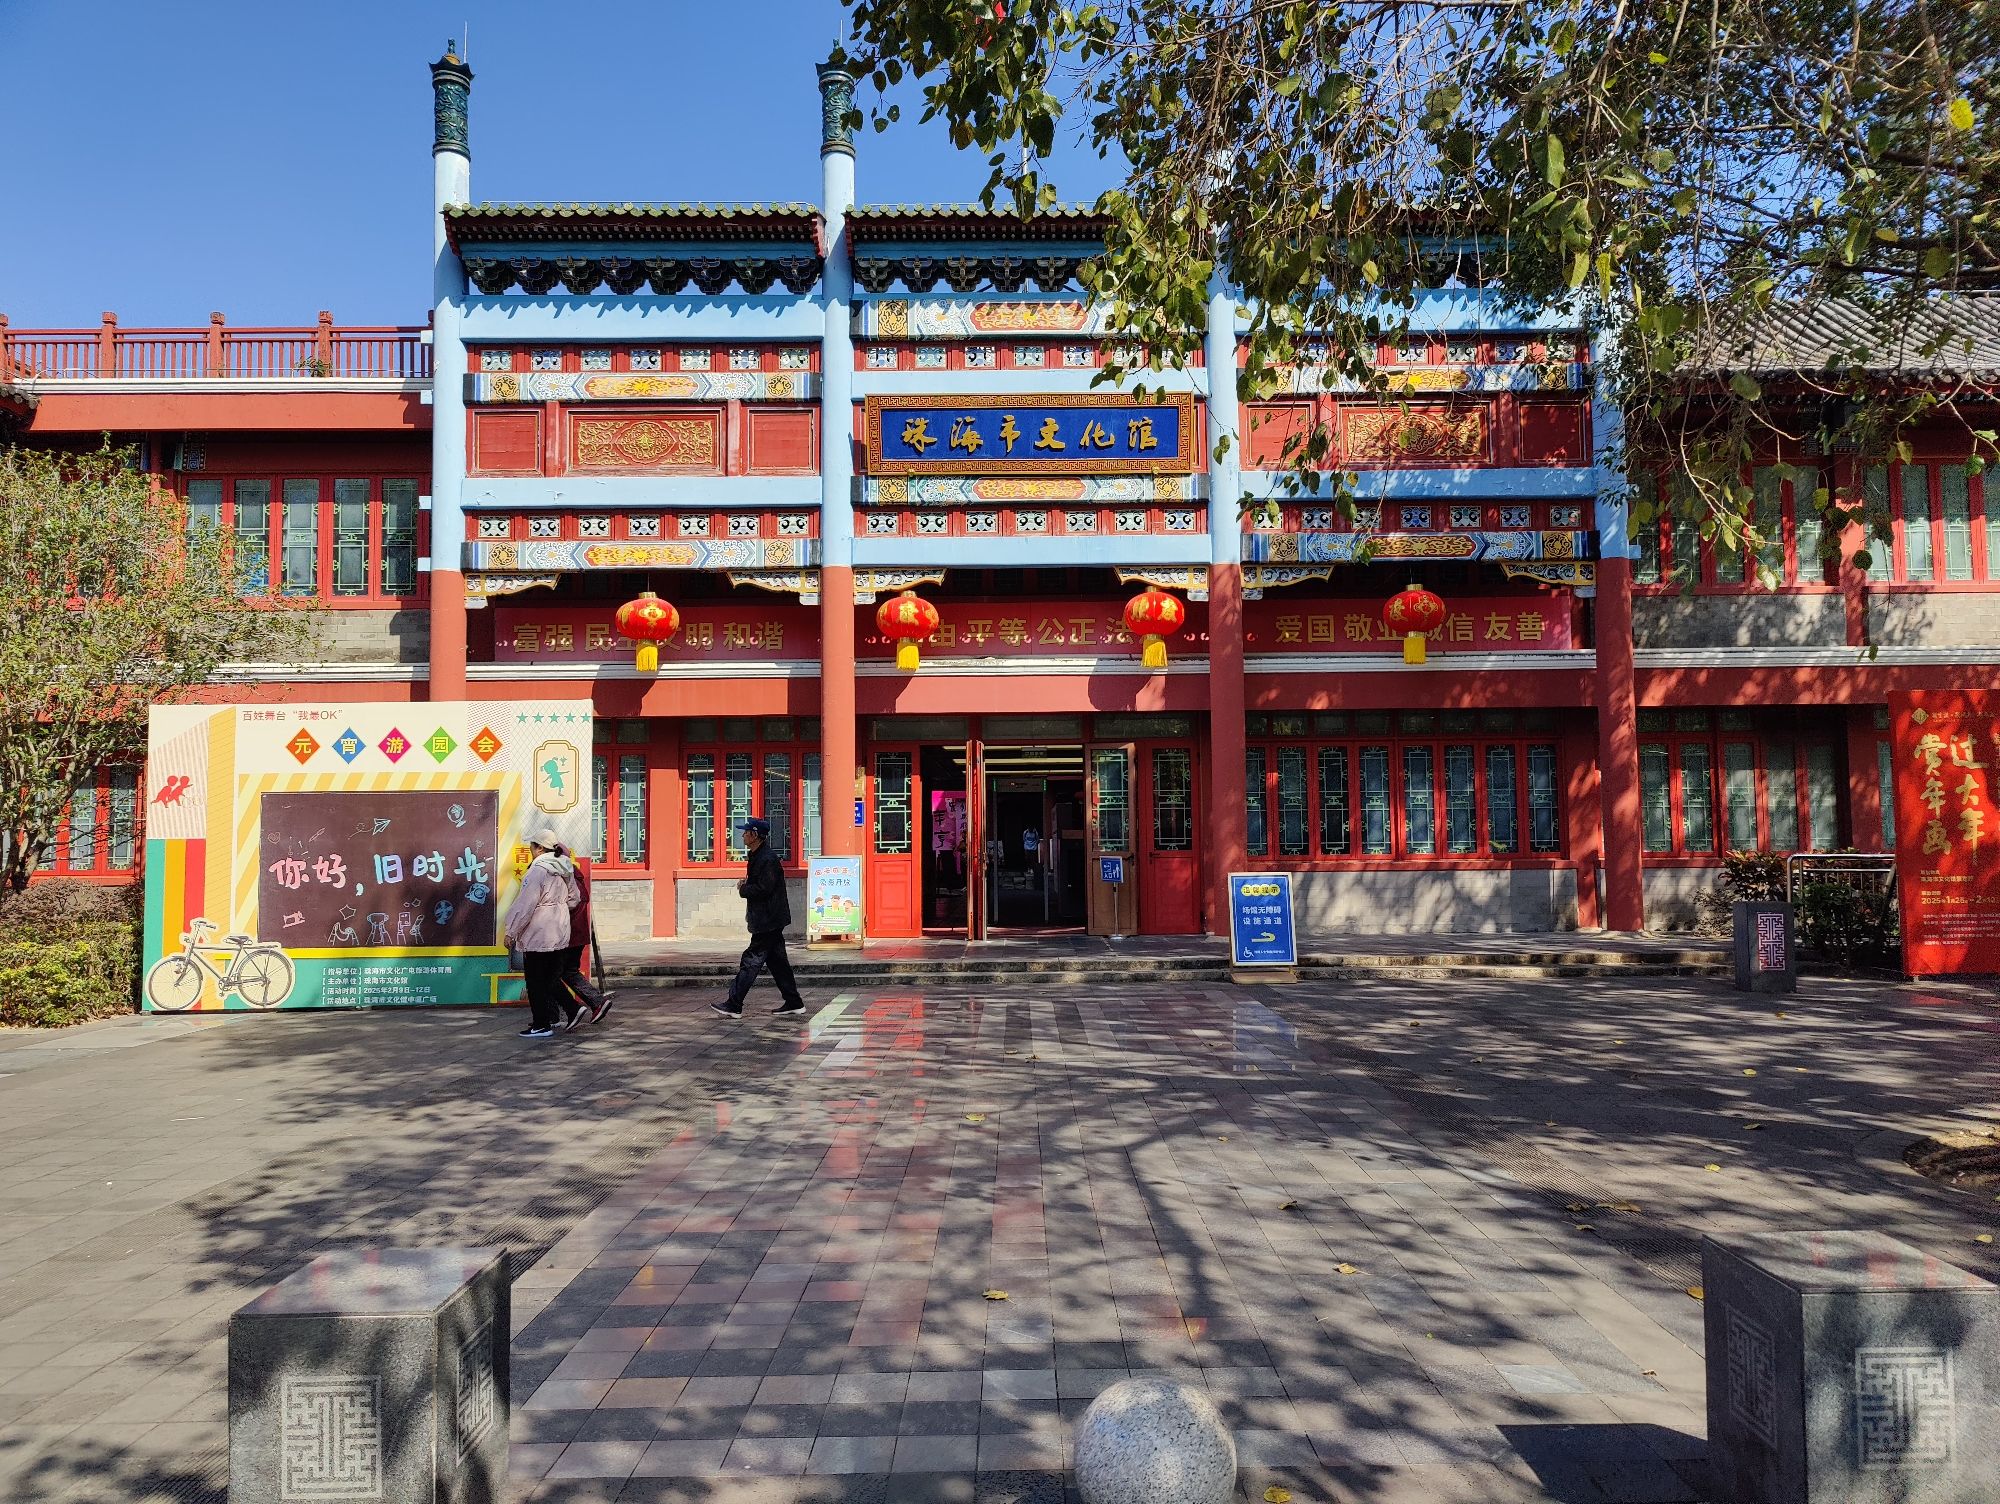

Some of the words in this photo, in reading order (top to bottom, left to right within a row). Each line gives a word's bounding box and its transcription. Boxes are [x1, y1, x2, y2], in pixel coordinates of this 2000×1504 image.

[901, 414, 1159, 455] 珠海市文化馆
[513, 623, 574, 653] 富强
[722, 621, 784, 651] 和谐
[967, 617, 1027, 648] 平等
[1036, 617, 1097, 647] 公正
[1275, 615, 1335, 643] 爱国
[1483, 611, 1546, 641] 友善
[242, 710, 286, 721] 百姓舞台
[294, 736, 495, 755] 元宵游园会
